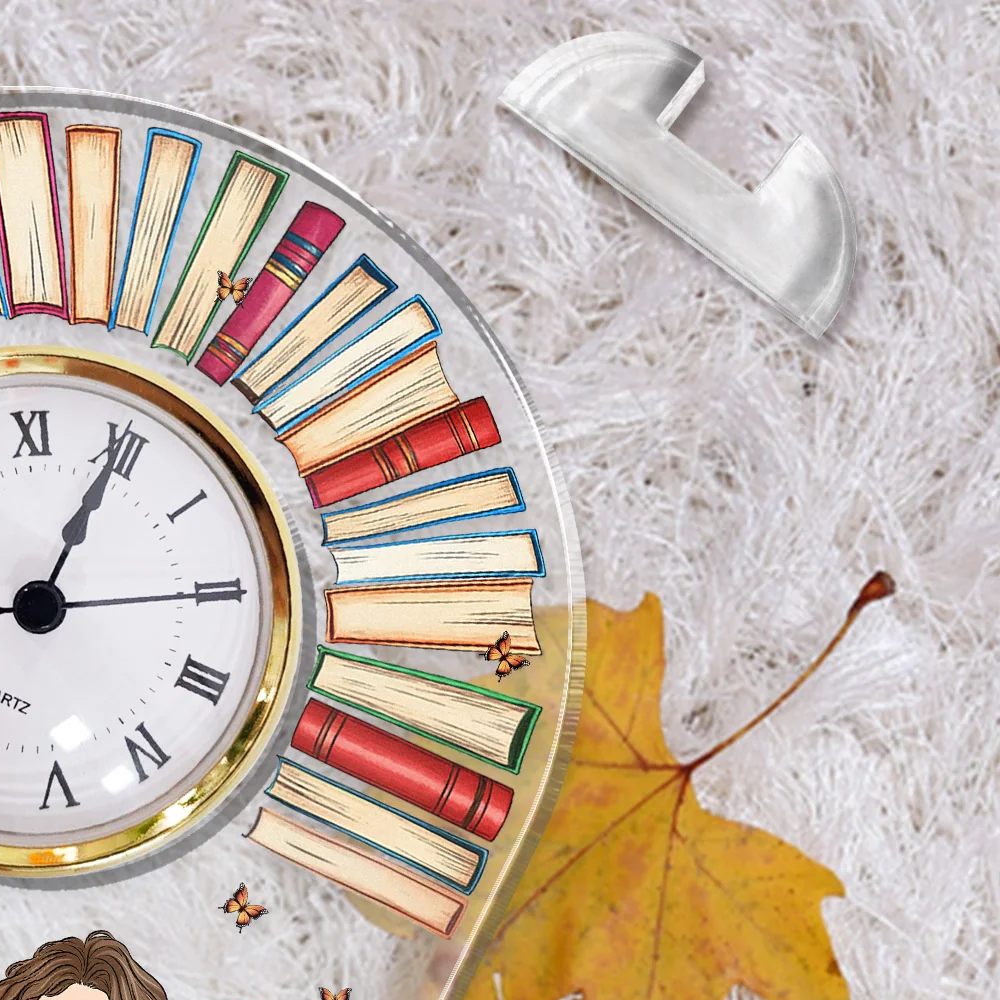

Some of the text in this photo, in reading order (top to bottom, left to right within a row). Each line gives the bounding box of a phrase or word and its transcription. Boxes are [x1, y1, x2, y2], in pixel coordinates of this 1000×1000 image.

[10, 410, 53, 459] XI
[166, 488, 208, 525] I
[173, 653, 231, 707] III
[123, 721, 172, 784] IV
[39, 759, 81, 810] V
